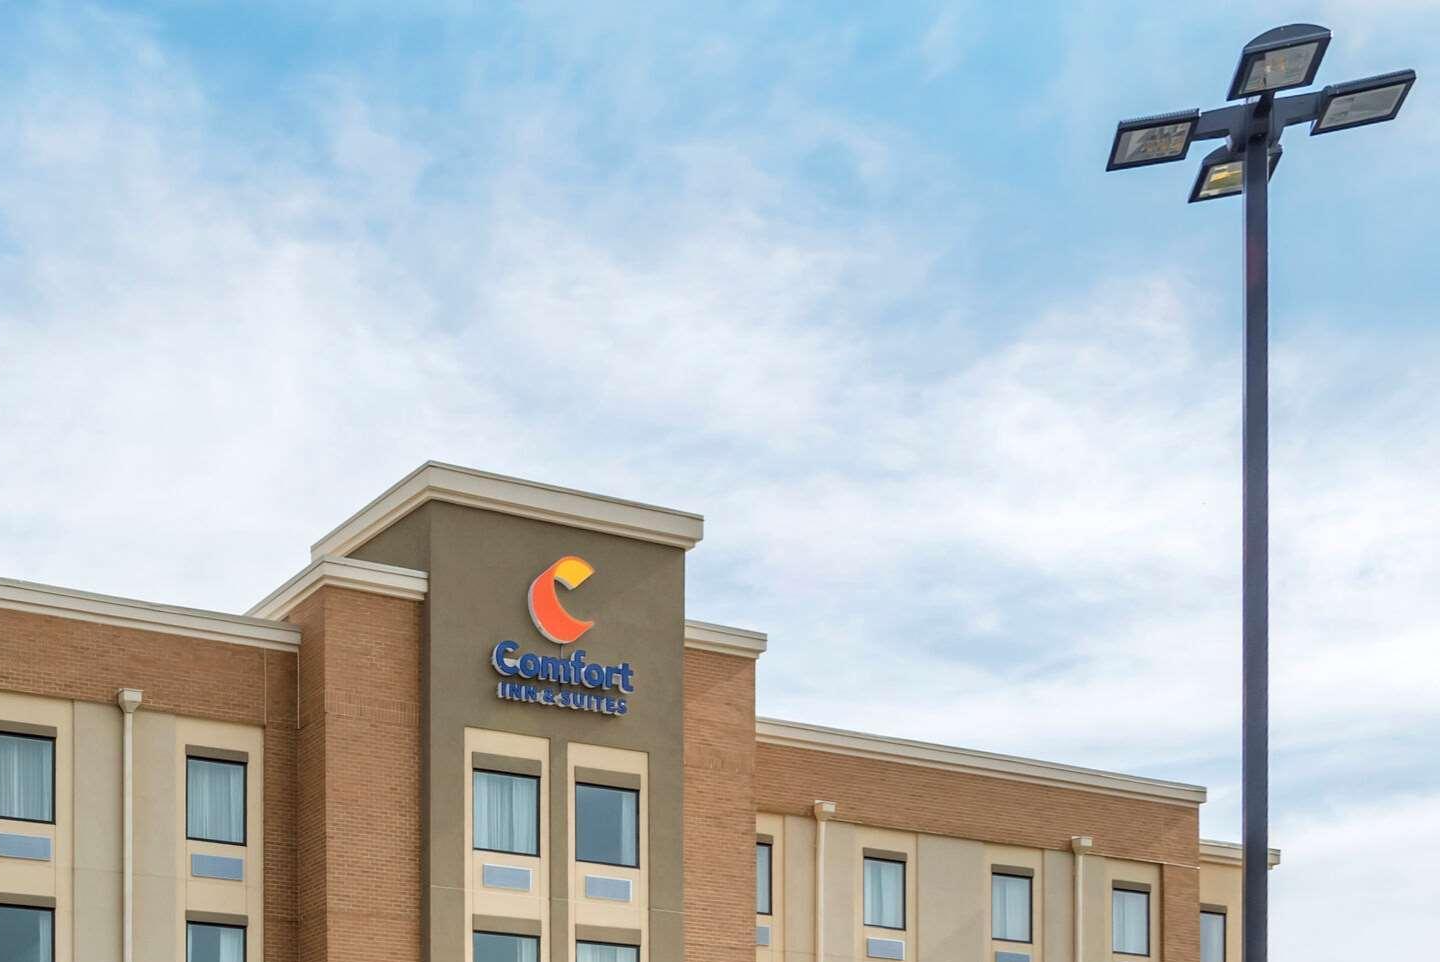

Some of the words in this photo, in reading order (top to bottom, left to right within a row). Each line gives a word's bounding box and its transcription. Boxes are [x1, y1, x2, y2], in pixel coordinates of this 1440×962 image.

[492, 640, 634, 693] Comfort
[498, 681, 538, 703] INN
[540, 687, 555, 705] &
[558, 689, 627, 716] SUITES
